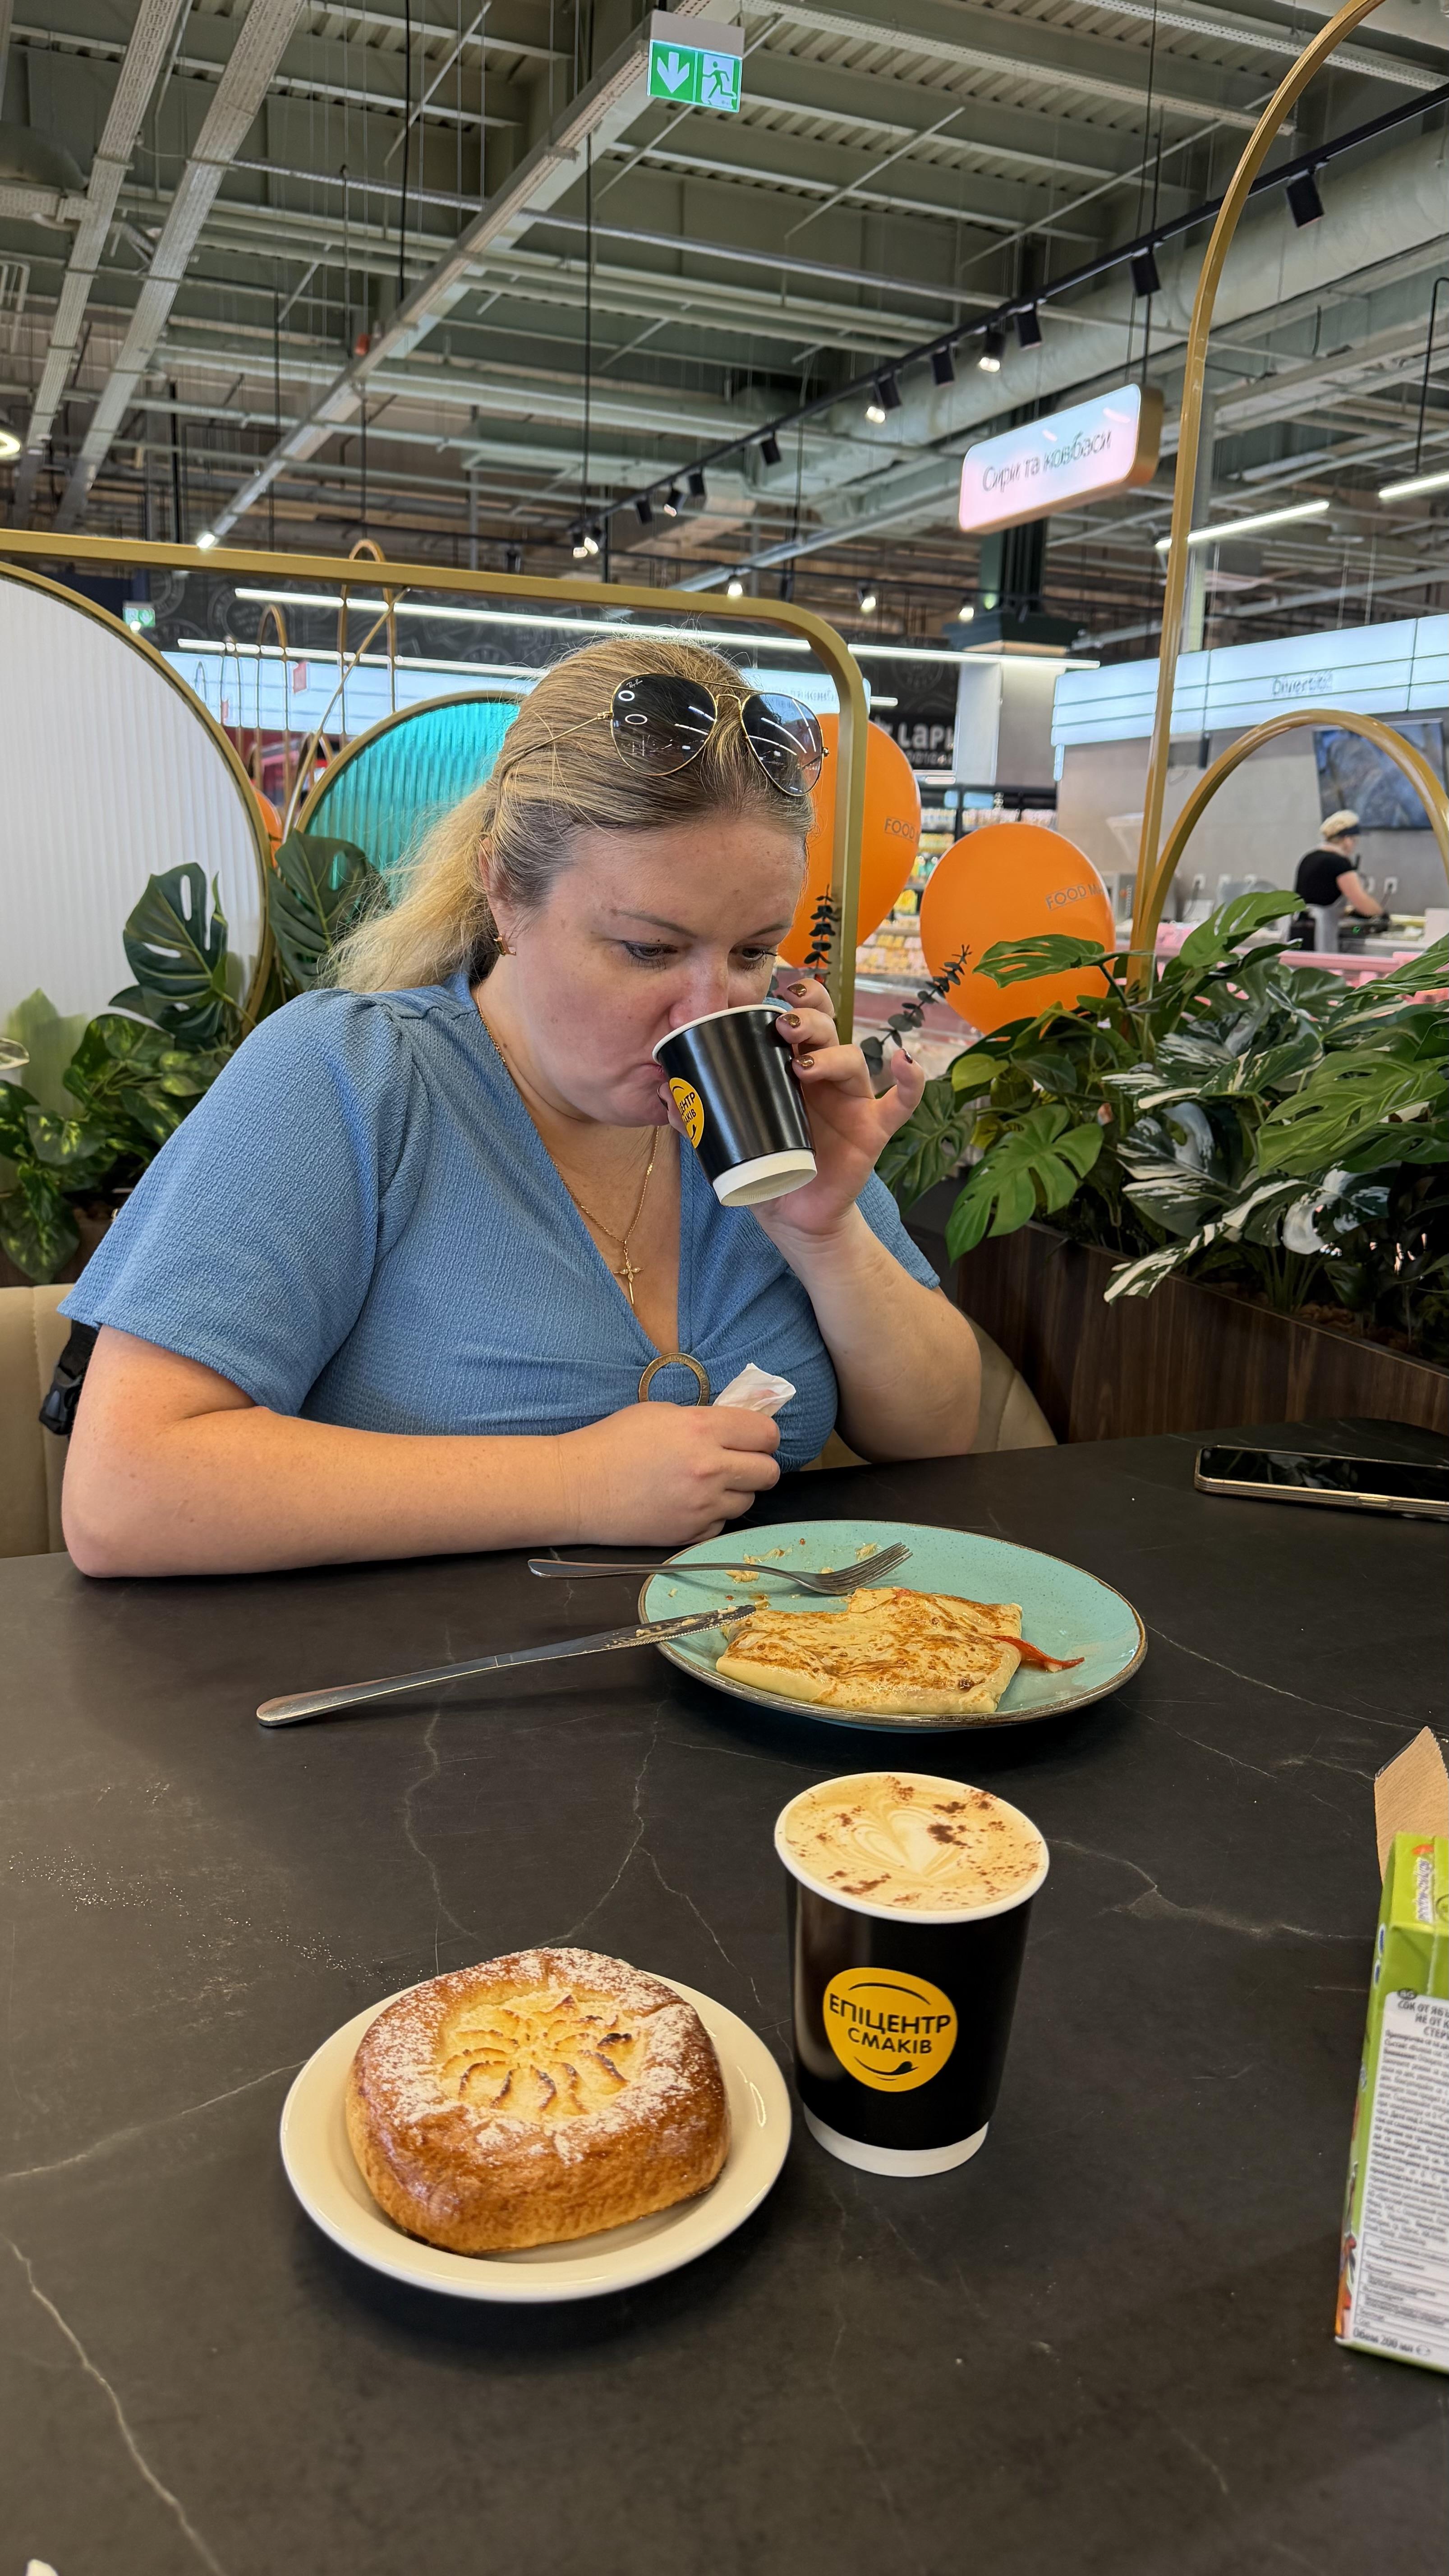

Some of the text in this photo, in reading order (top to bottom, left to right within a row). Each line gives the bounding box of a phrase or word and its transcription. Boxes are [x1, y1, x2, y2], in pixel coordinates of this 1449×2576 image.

[983, 430, 1111, 492] Сири та ковбаси
[884, 818, 915, 839] FOOD
[1046, 885, 1086, 909] FOOD
[829, 1993, 951, 2034] ЕПІЦЕНТР
[1398, 2000, 1416, 2011] СОК
[1417, 2004, 1429, 2013] ОТ
[1429, 2017, 1441, 2026] ОТ
[848, 2028, 932, 2054] СМАКІВ
